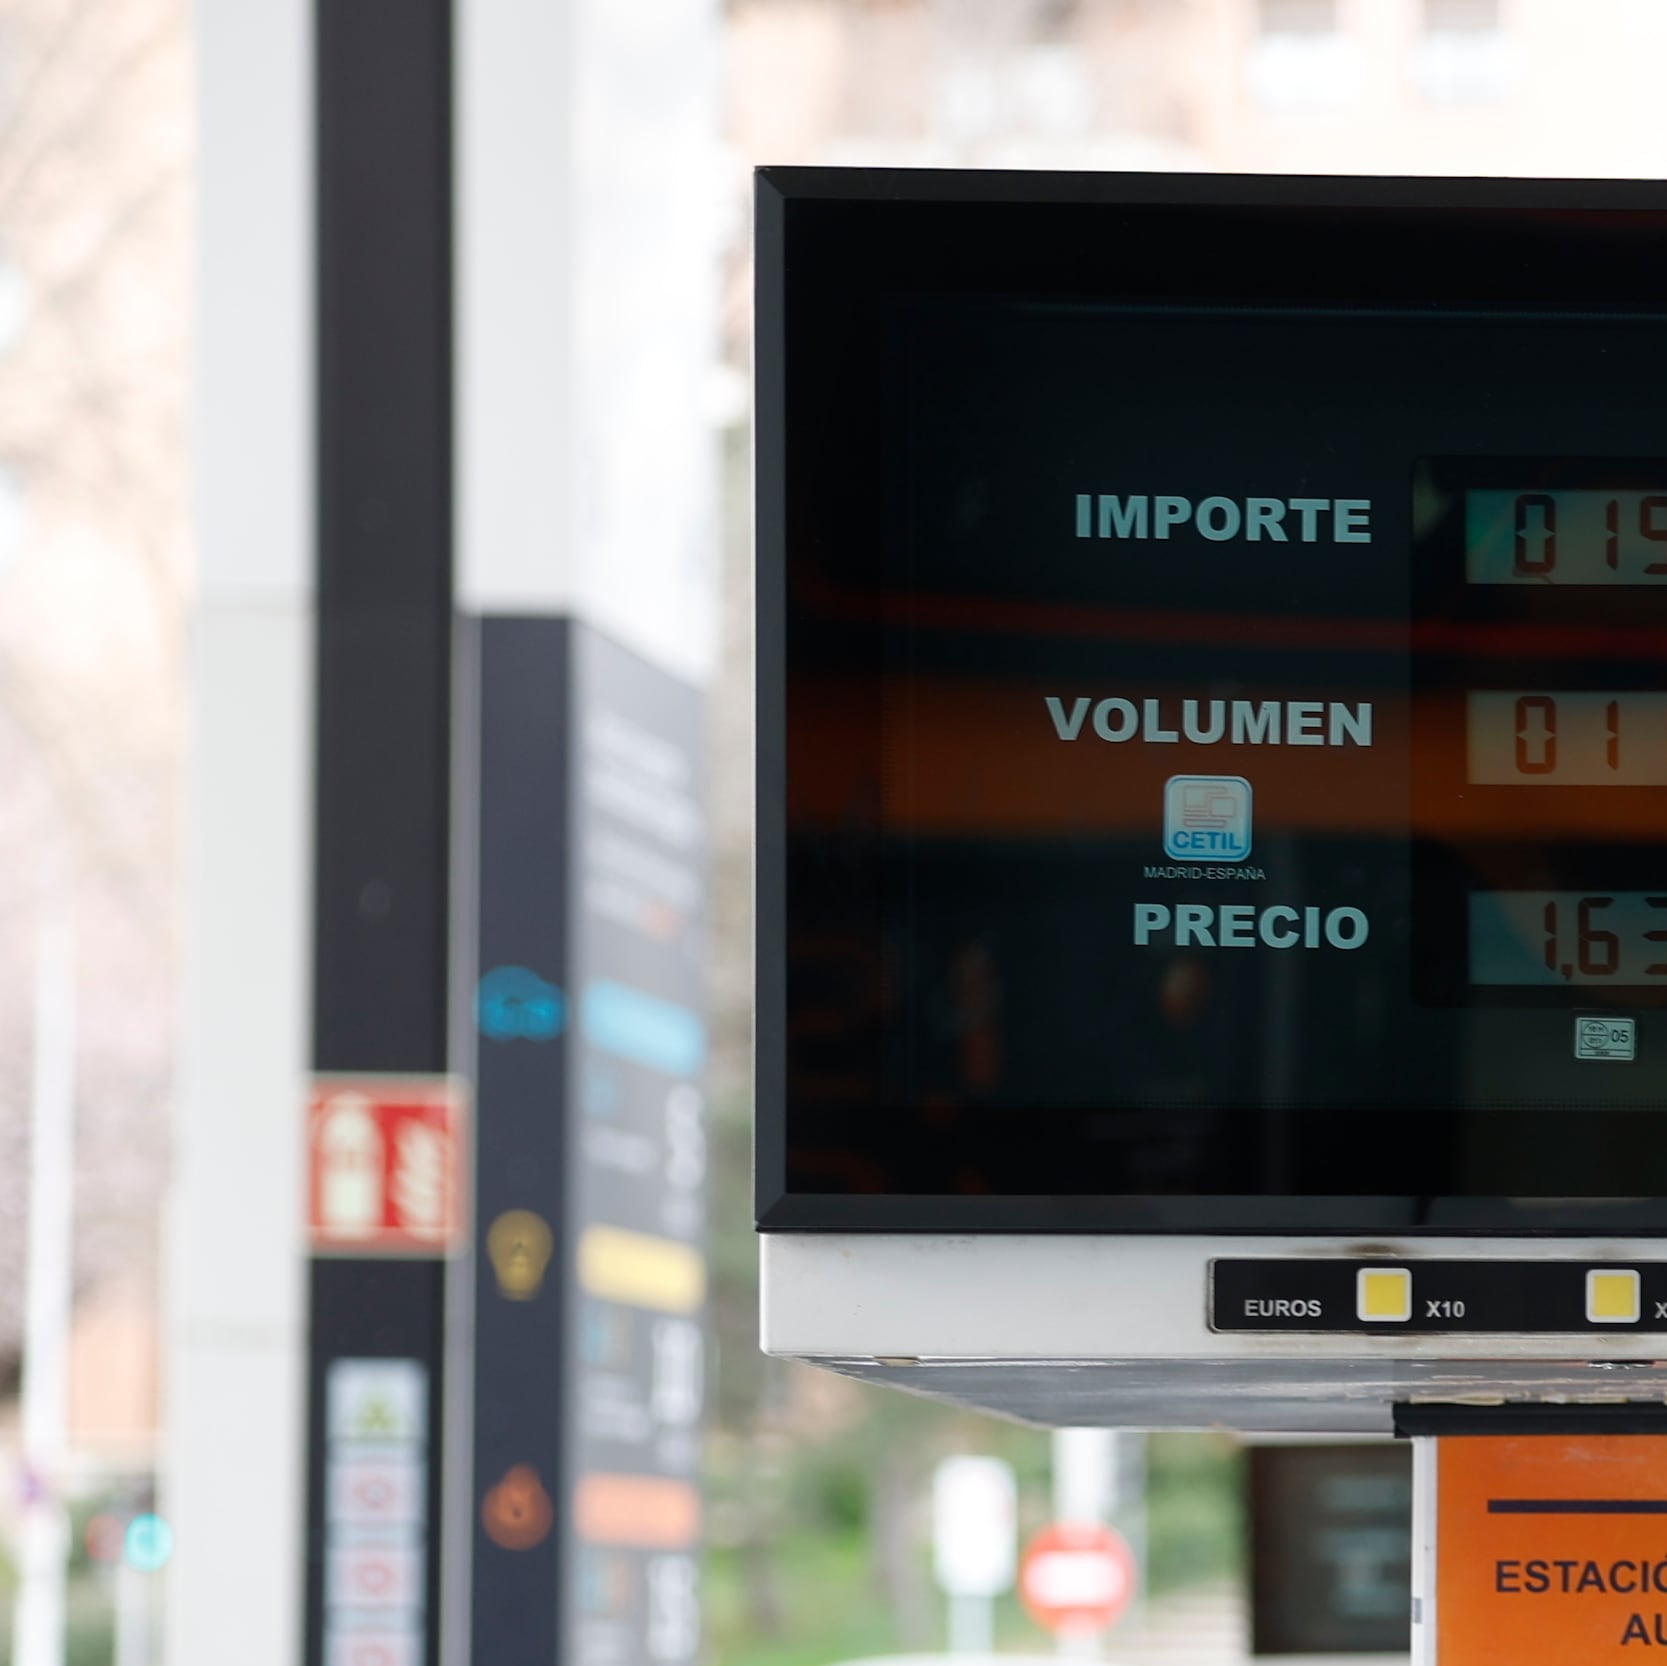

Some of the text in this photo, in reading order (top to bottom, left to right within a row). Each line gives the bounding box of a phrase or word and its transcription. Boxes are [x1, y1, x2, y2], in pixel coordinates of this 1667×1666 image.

[1075, 493, 1372, 544] IMPORTE
[1045, 697, 1373, 747] VOLUMEN
[1172, 831, 1242, 851] CETIL
[1144, 866, 1266, 881] MADRID-ESPAÑA
[1133, 903, 1370, 950] PRECIO
[1611, 1029, 1629, 1043] 05
[1245, 1299, 1322, 1319] EUROS
[1426, 1299, 1466, 1319] X10
